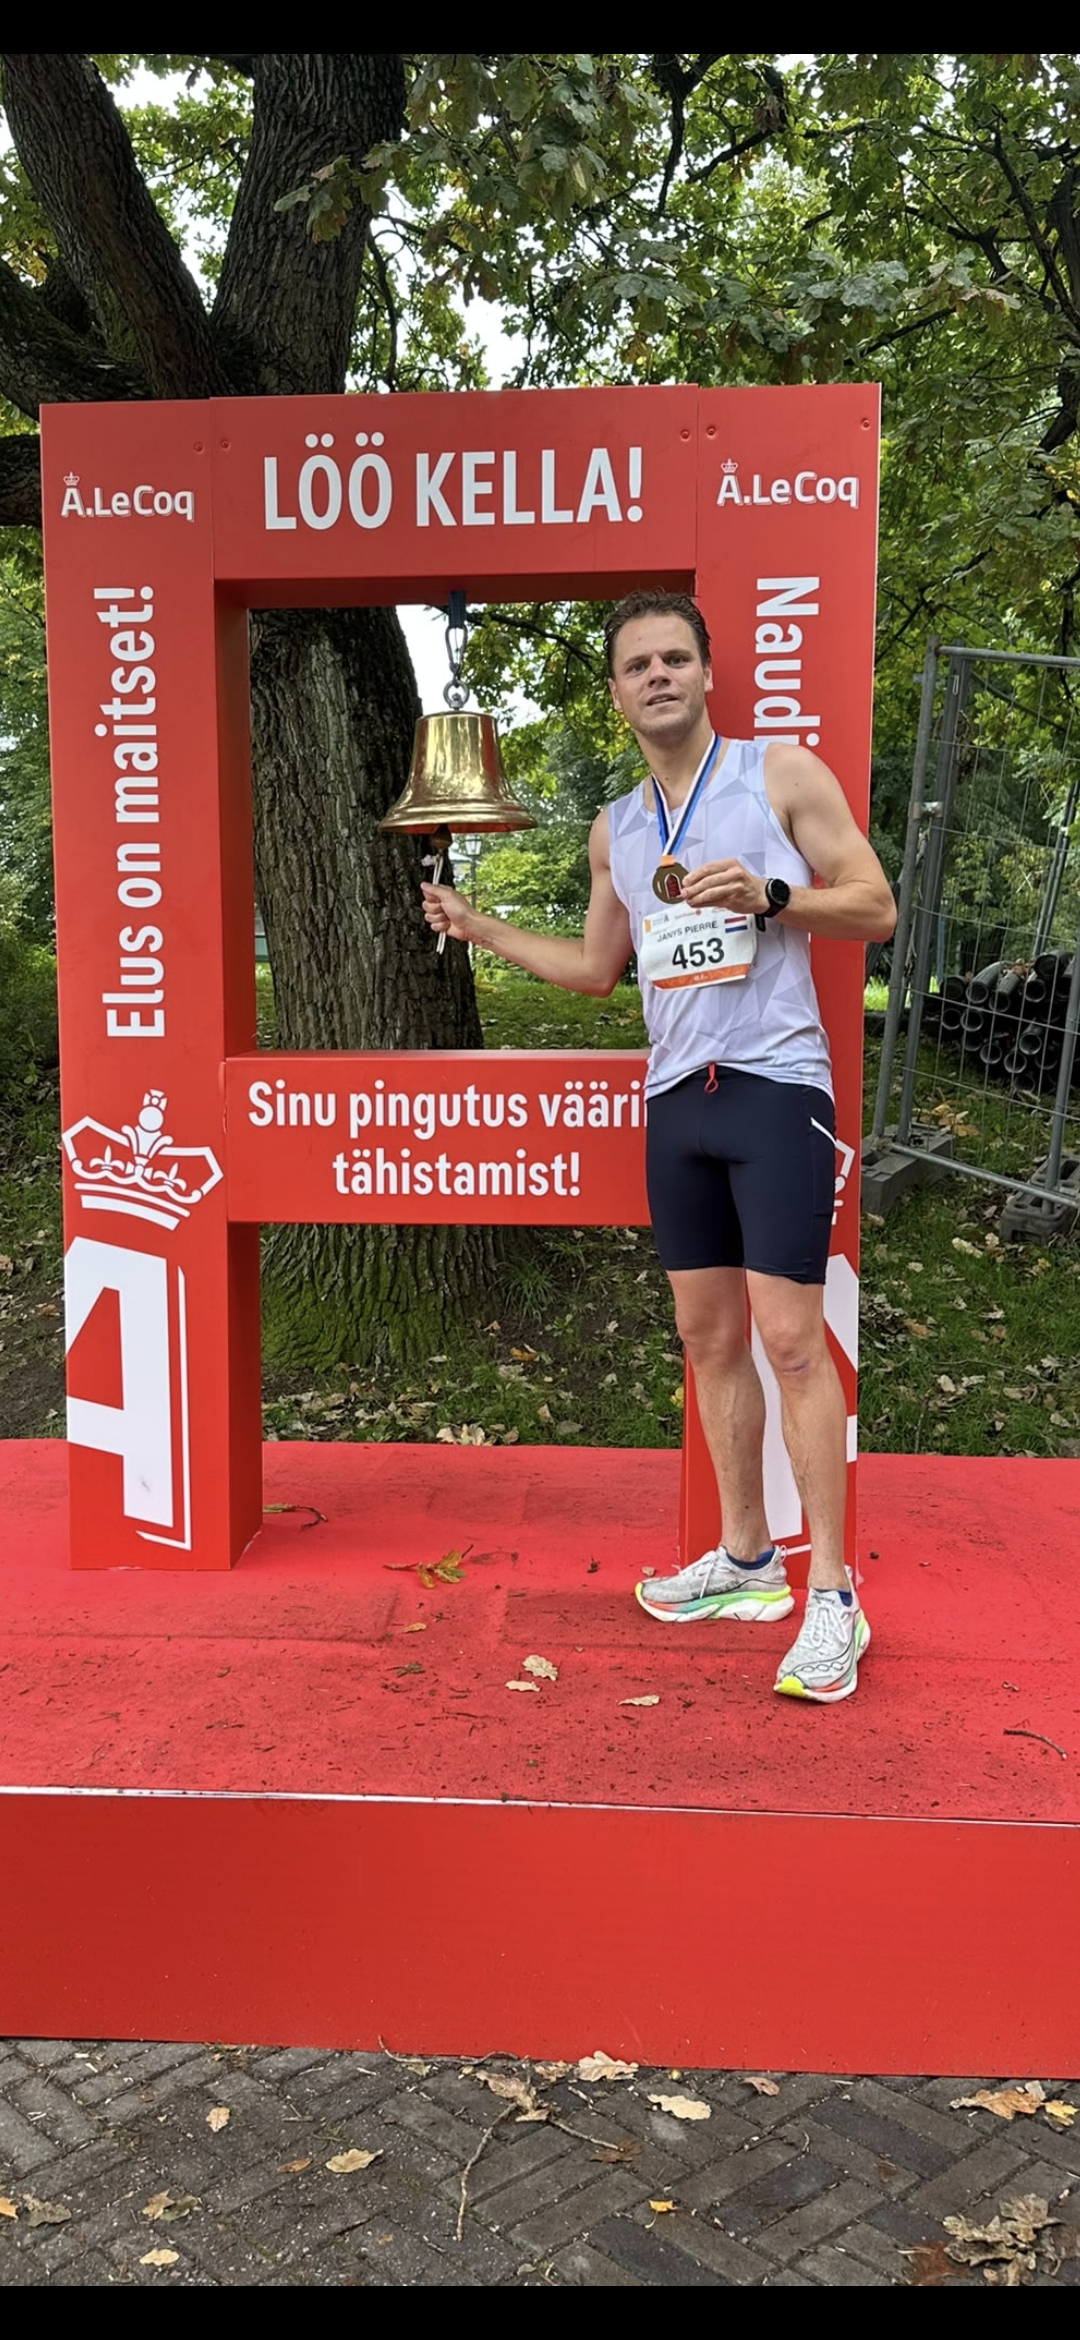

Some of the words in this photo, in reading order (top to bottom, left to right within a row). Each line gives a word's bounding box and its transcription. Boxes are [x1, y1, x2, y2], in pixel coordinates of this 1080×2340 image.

[264, 432, 393, 530] LÖÖ
[416, 447, 643, 527] KELLA!
[93, 585, 160, 823] maitset!
[116, 842, 163, 909] on
[672, 937, 725, 969] 453
[684, 921, 719, 934] PIERRE
[101, 924, 166, 1038] Elus
[248, 1079, 336, 1127] Sinu
[349, 1079, 528, 1140] pingutus
[539, 1080, 648, 1128] vääri
[332, 1147, 580, 1197] tähistamist!
